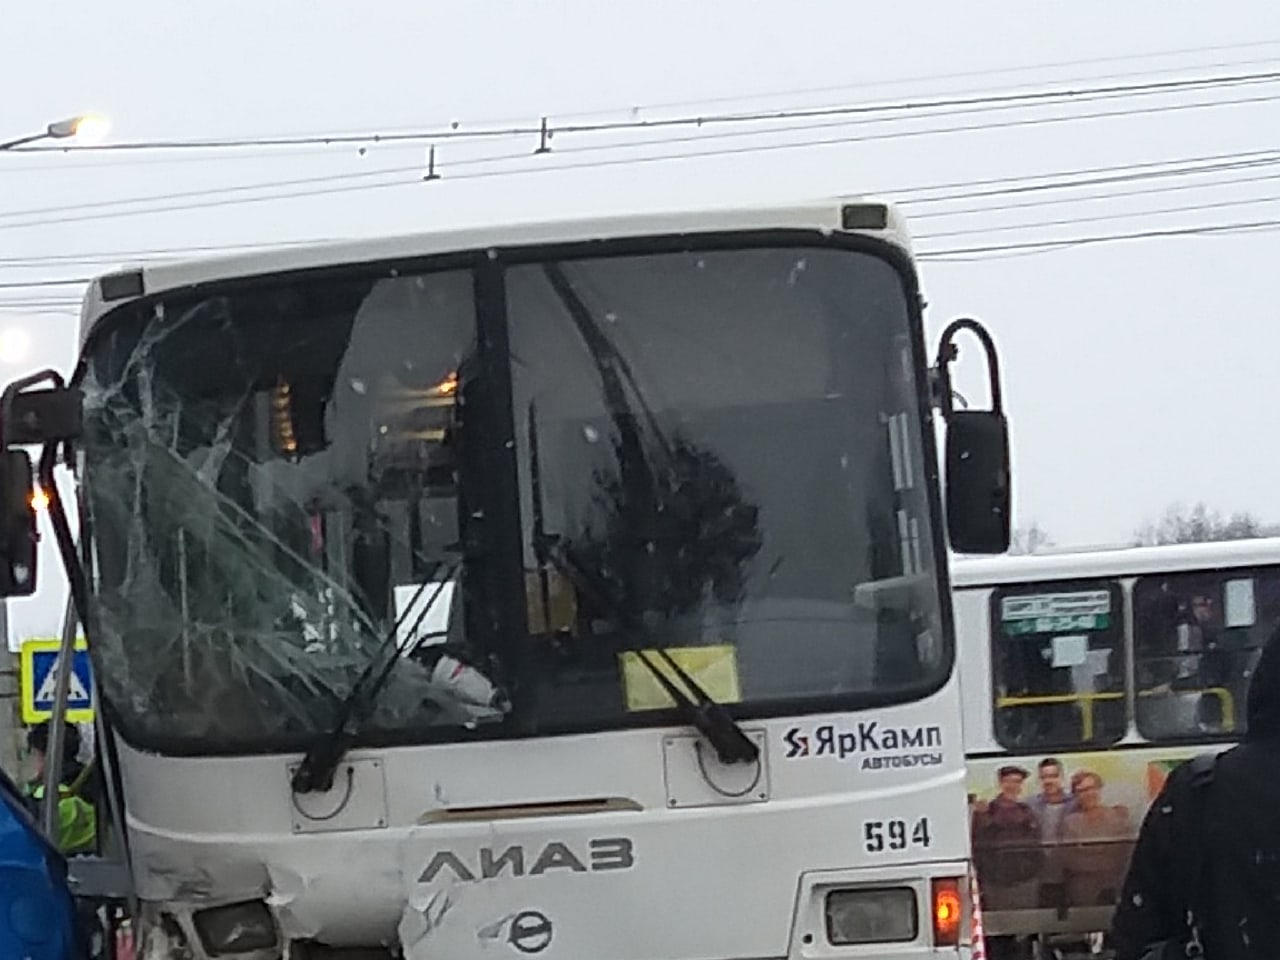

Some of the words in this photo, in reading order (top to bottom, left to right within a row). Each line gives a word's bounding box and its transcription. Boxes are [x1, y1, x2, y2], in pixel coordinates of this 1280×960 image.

[815, 721, 942, 758] ЯрКамп
[861, 753, 943, 770] АВТОБУСЫ
[864, 817, 931, 852] 594
[417, 837, 635, 883] ЛИАЗ
